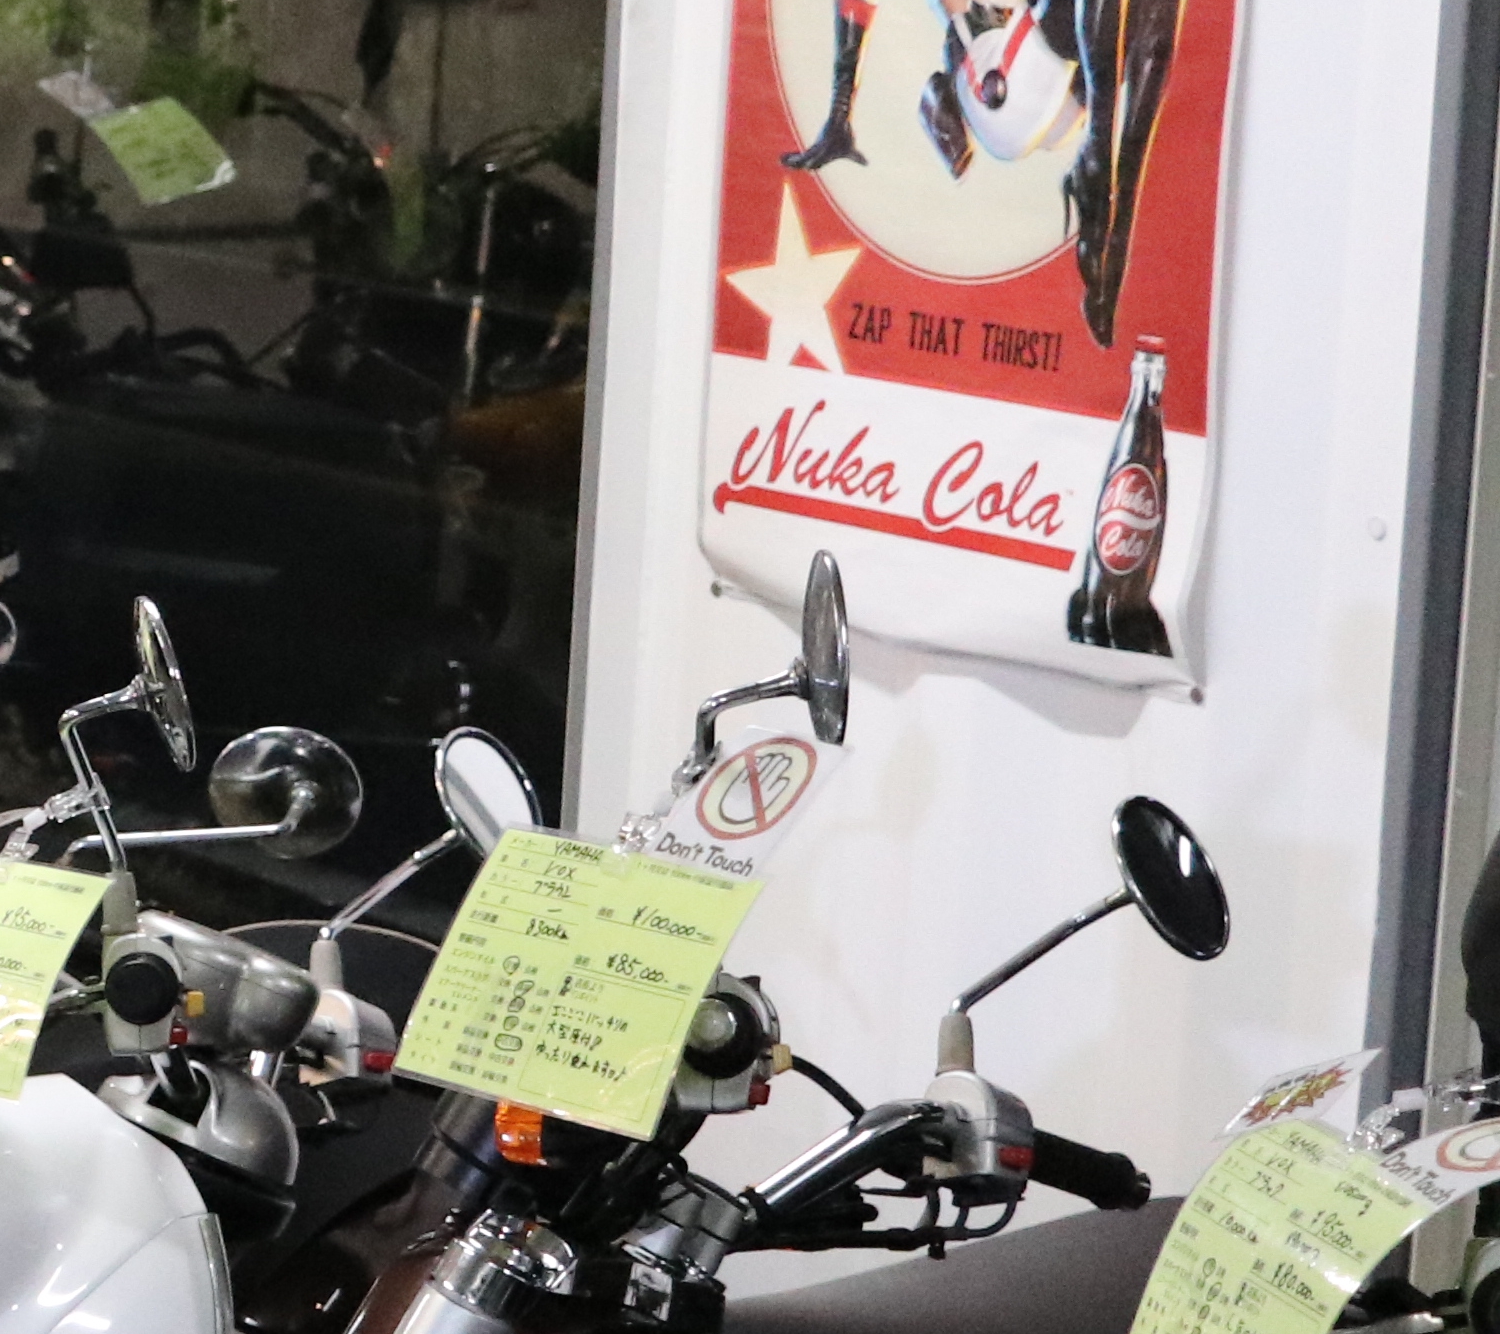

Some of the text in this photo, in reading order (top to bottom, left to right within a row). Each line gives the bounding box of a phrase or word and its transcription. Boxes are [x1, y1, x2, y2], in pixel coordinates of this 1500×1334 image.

[848, 302, 1064, 373] ZAP THAT THIRST!
[731, 399, 1066, 538] Nuka Cola
[654, 831, 754, 879] Don't Touch
[1379, 1150, 1422, 1186] Don't
[1412, 1167, 1458, 1207] Touch
